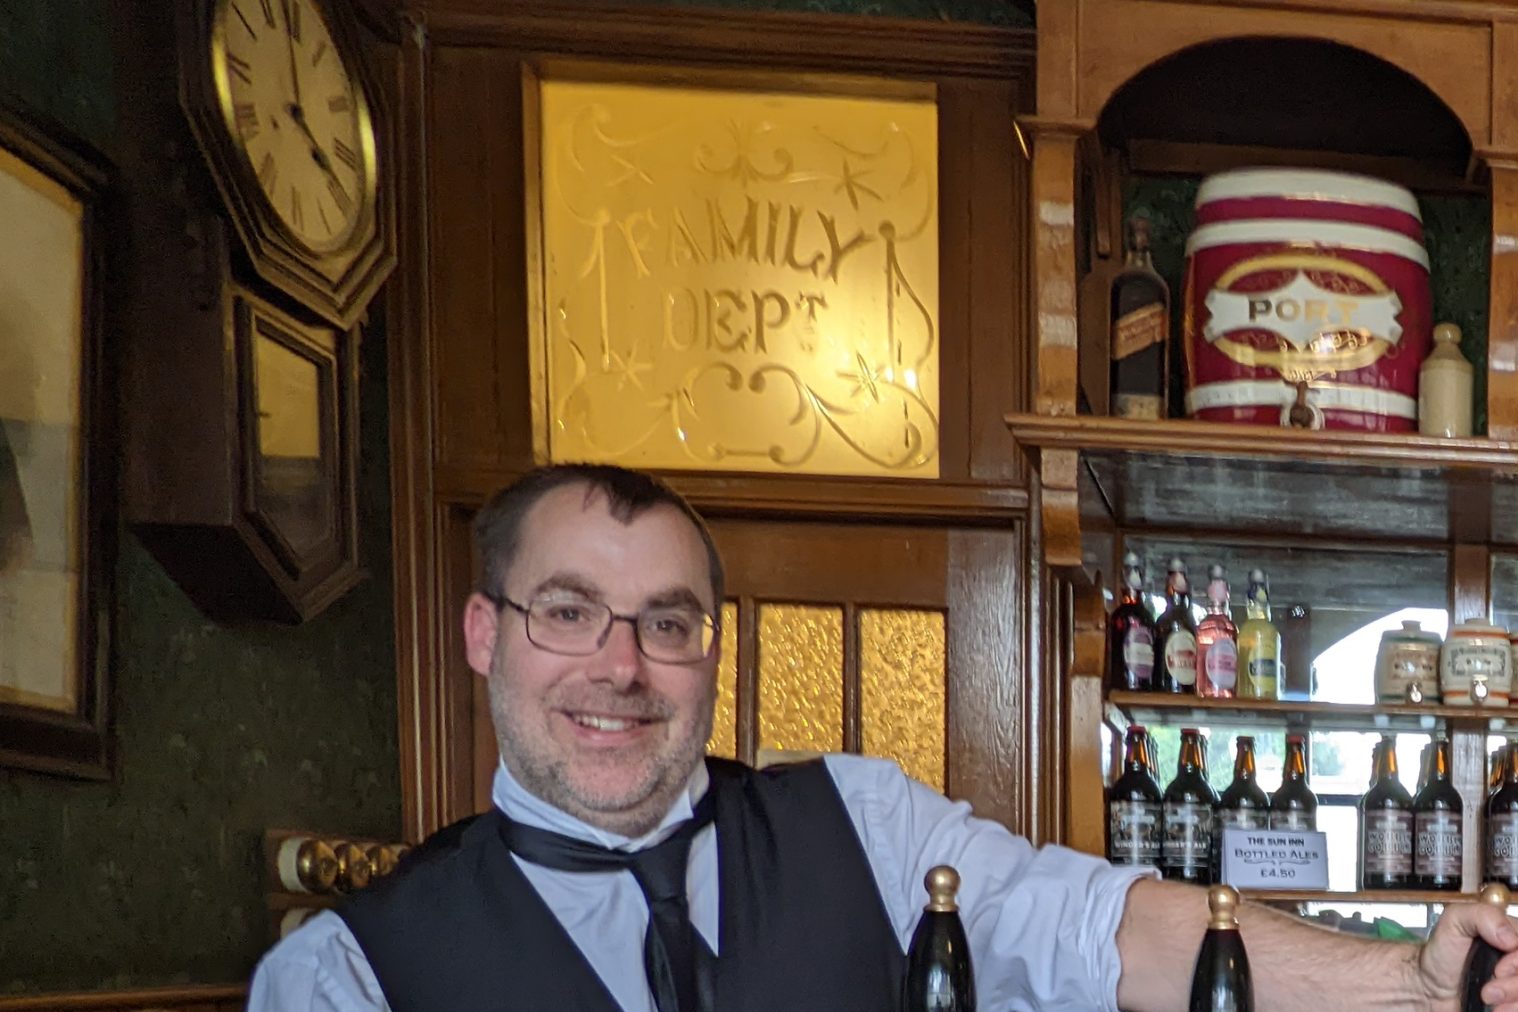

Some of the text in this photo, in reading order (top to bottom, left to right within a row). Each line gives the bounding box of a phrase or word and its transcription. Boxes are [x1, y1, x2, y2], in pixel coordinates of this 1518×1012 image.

[616, 196, 876, 283] FAMILY
[1247, 298, 1360, 324] PORT
[1247, 837, 1305, 847] THE SUN INN
[1290, 850, 1319, 860] ALES
